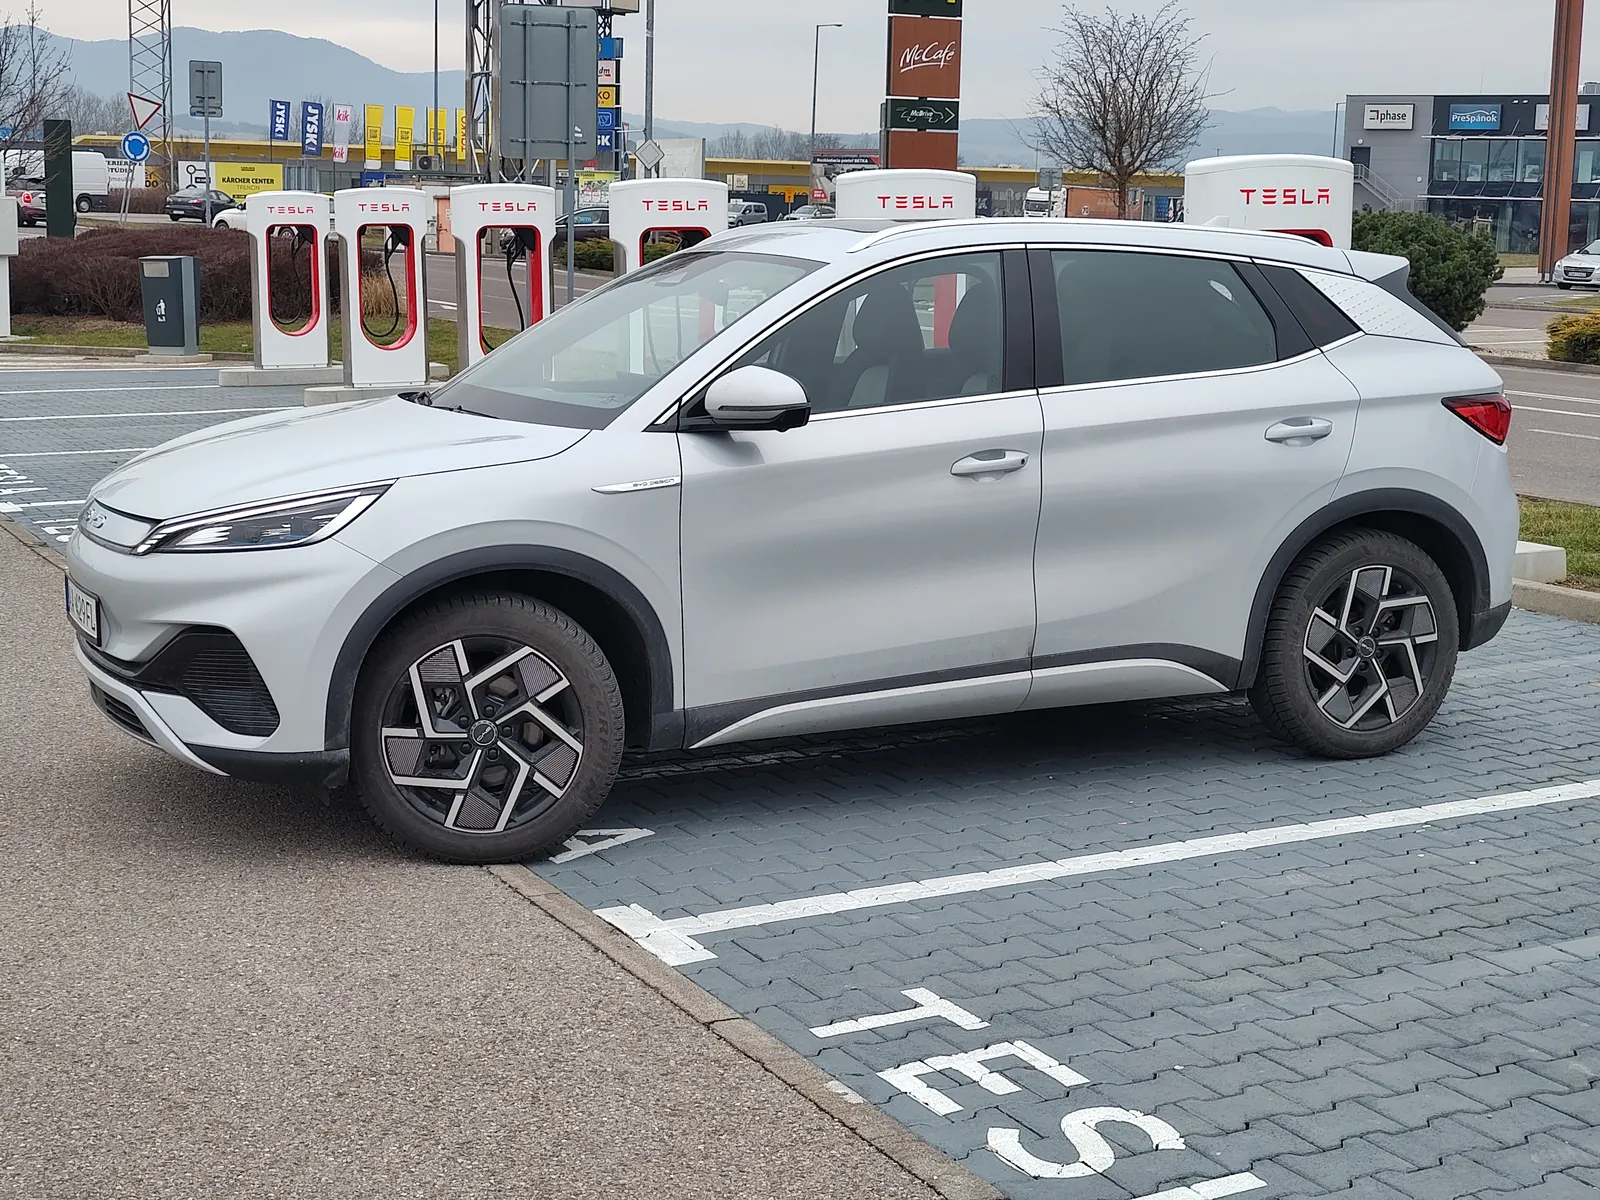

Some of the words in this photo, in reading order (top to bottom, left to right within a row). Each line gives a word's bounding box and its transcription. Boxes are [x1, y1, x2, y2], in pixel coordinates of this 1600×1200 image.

[275, 102, 286, 133] JYSK
[336, 109, 350, 122] kik
[910, 109, 934, 117] McDrive
[1451, 113, 1497, 124] PreSpánok
[305, 105, 319, 146] JYSK
[333, 146, 345, 159] kik
[221, 176, 250, 184] KÄRCHER
[251, 177, 274, 185] CENTER
[877, 196, 953, 208] TESLA
[1239, 188, 1330, 205] TESLA
[267, 206, 314, 214] TESLA
[358, 203, 410, 212] TESLA
[478, 202, 537, 212] TESLA
[642, 200, 708, 211] TESLA
